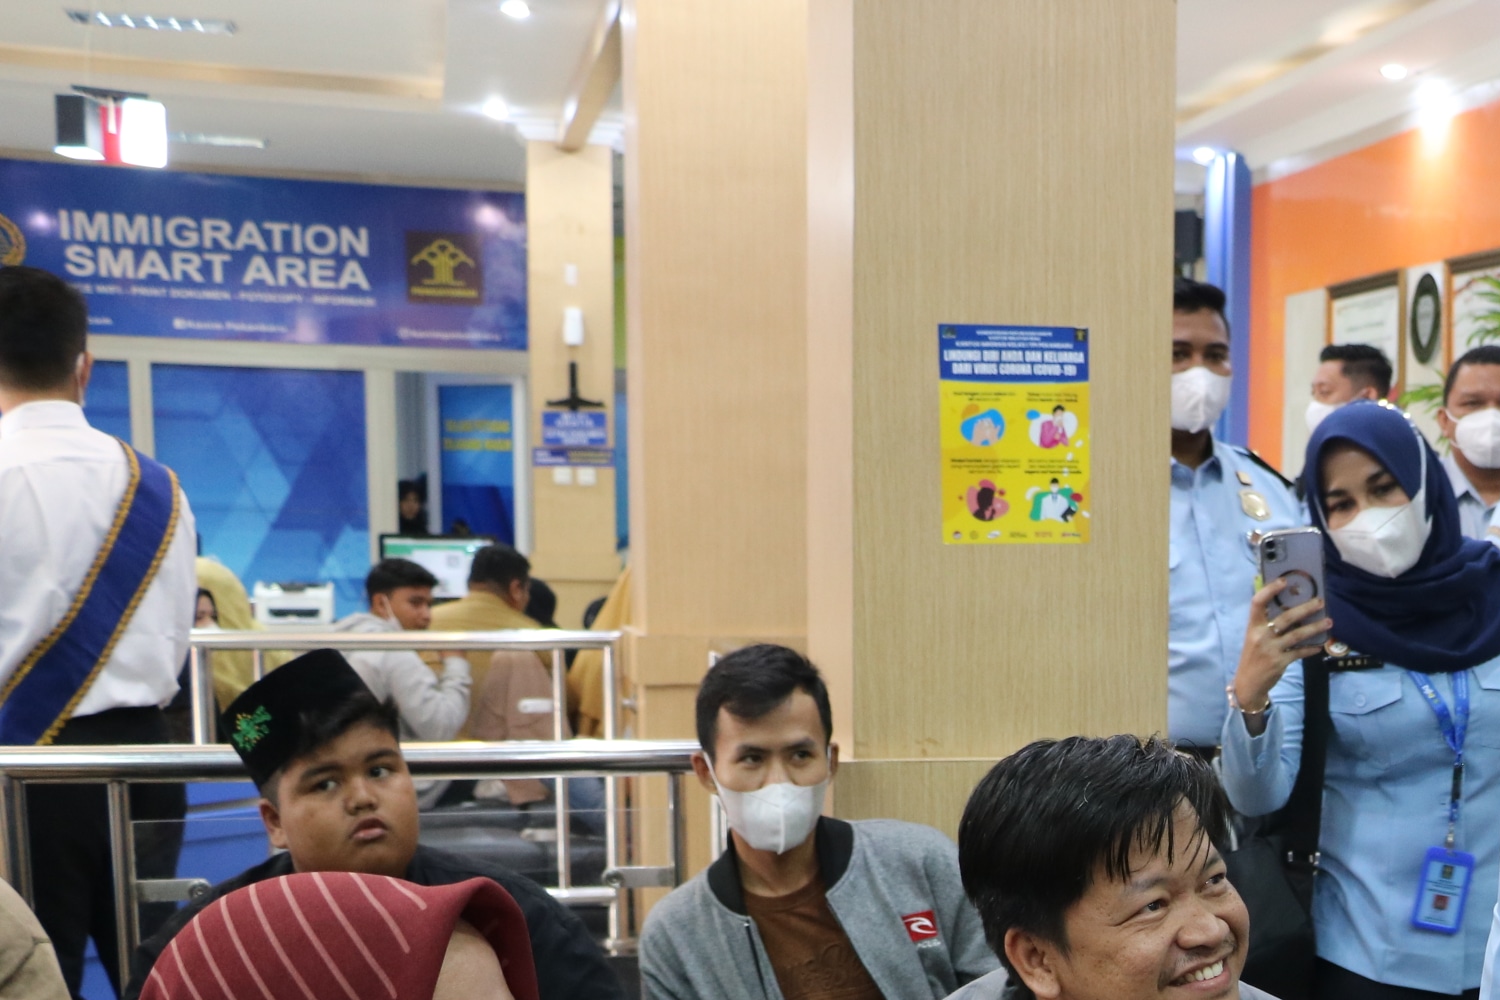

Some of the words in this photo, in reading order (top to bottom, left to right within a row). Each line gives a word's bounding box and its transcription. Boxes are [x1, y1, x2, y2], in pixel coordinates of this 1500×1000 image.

[58, 209, 369, 257] IMMIGRATION
[65, 244, 231, 284] SMART
[242, 255, 371, 291] AREA
